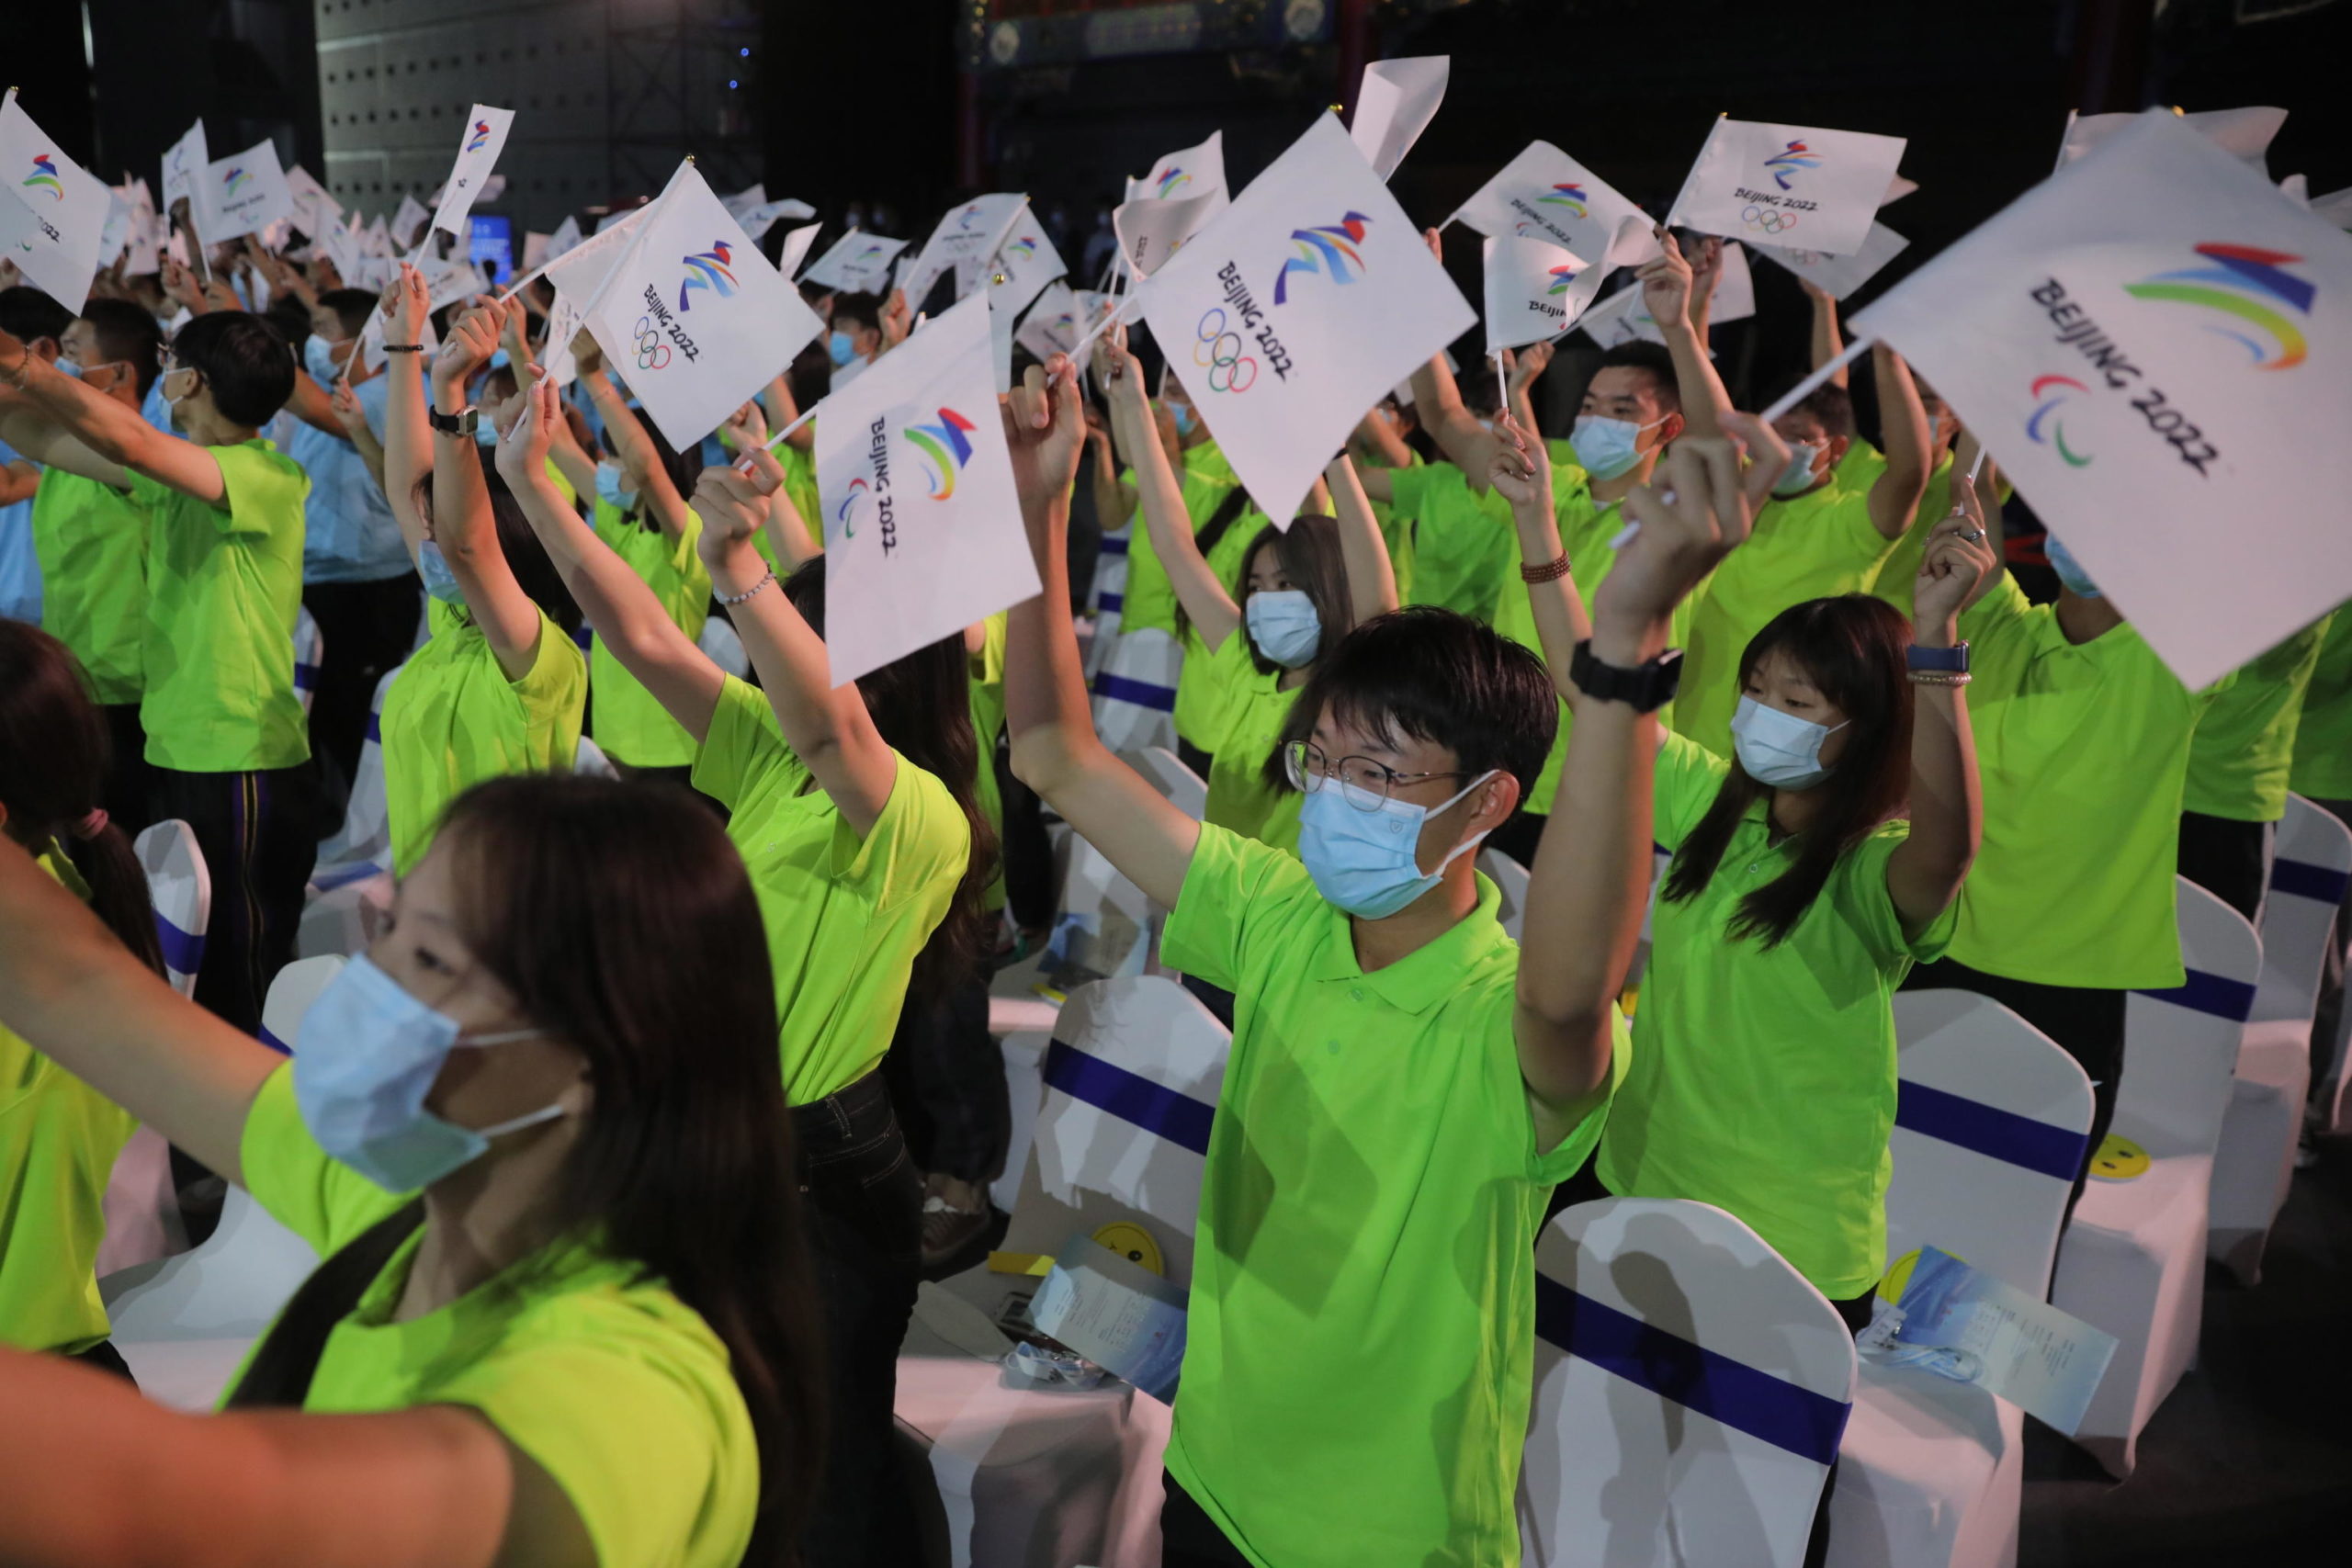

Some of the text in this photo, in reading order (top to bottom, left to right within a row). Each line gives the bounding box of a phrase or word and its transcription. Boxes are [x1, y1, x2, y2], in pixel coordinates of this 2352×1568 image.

[1510, 197, 1572, 243] BEIJING 2022
[1734, 187, 1818, 210] BEIJING 2022
[644, 283, 699, 364] BEIJING 2022
[1217, 260, 1292, 383] BEIJING 2022
[2030, 277, 2220, 479] BEIJING 2022
[869, 416, 897, 559] BEIJING 2022
